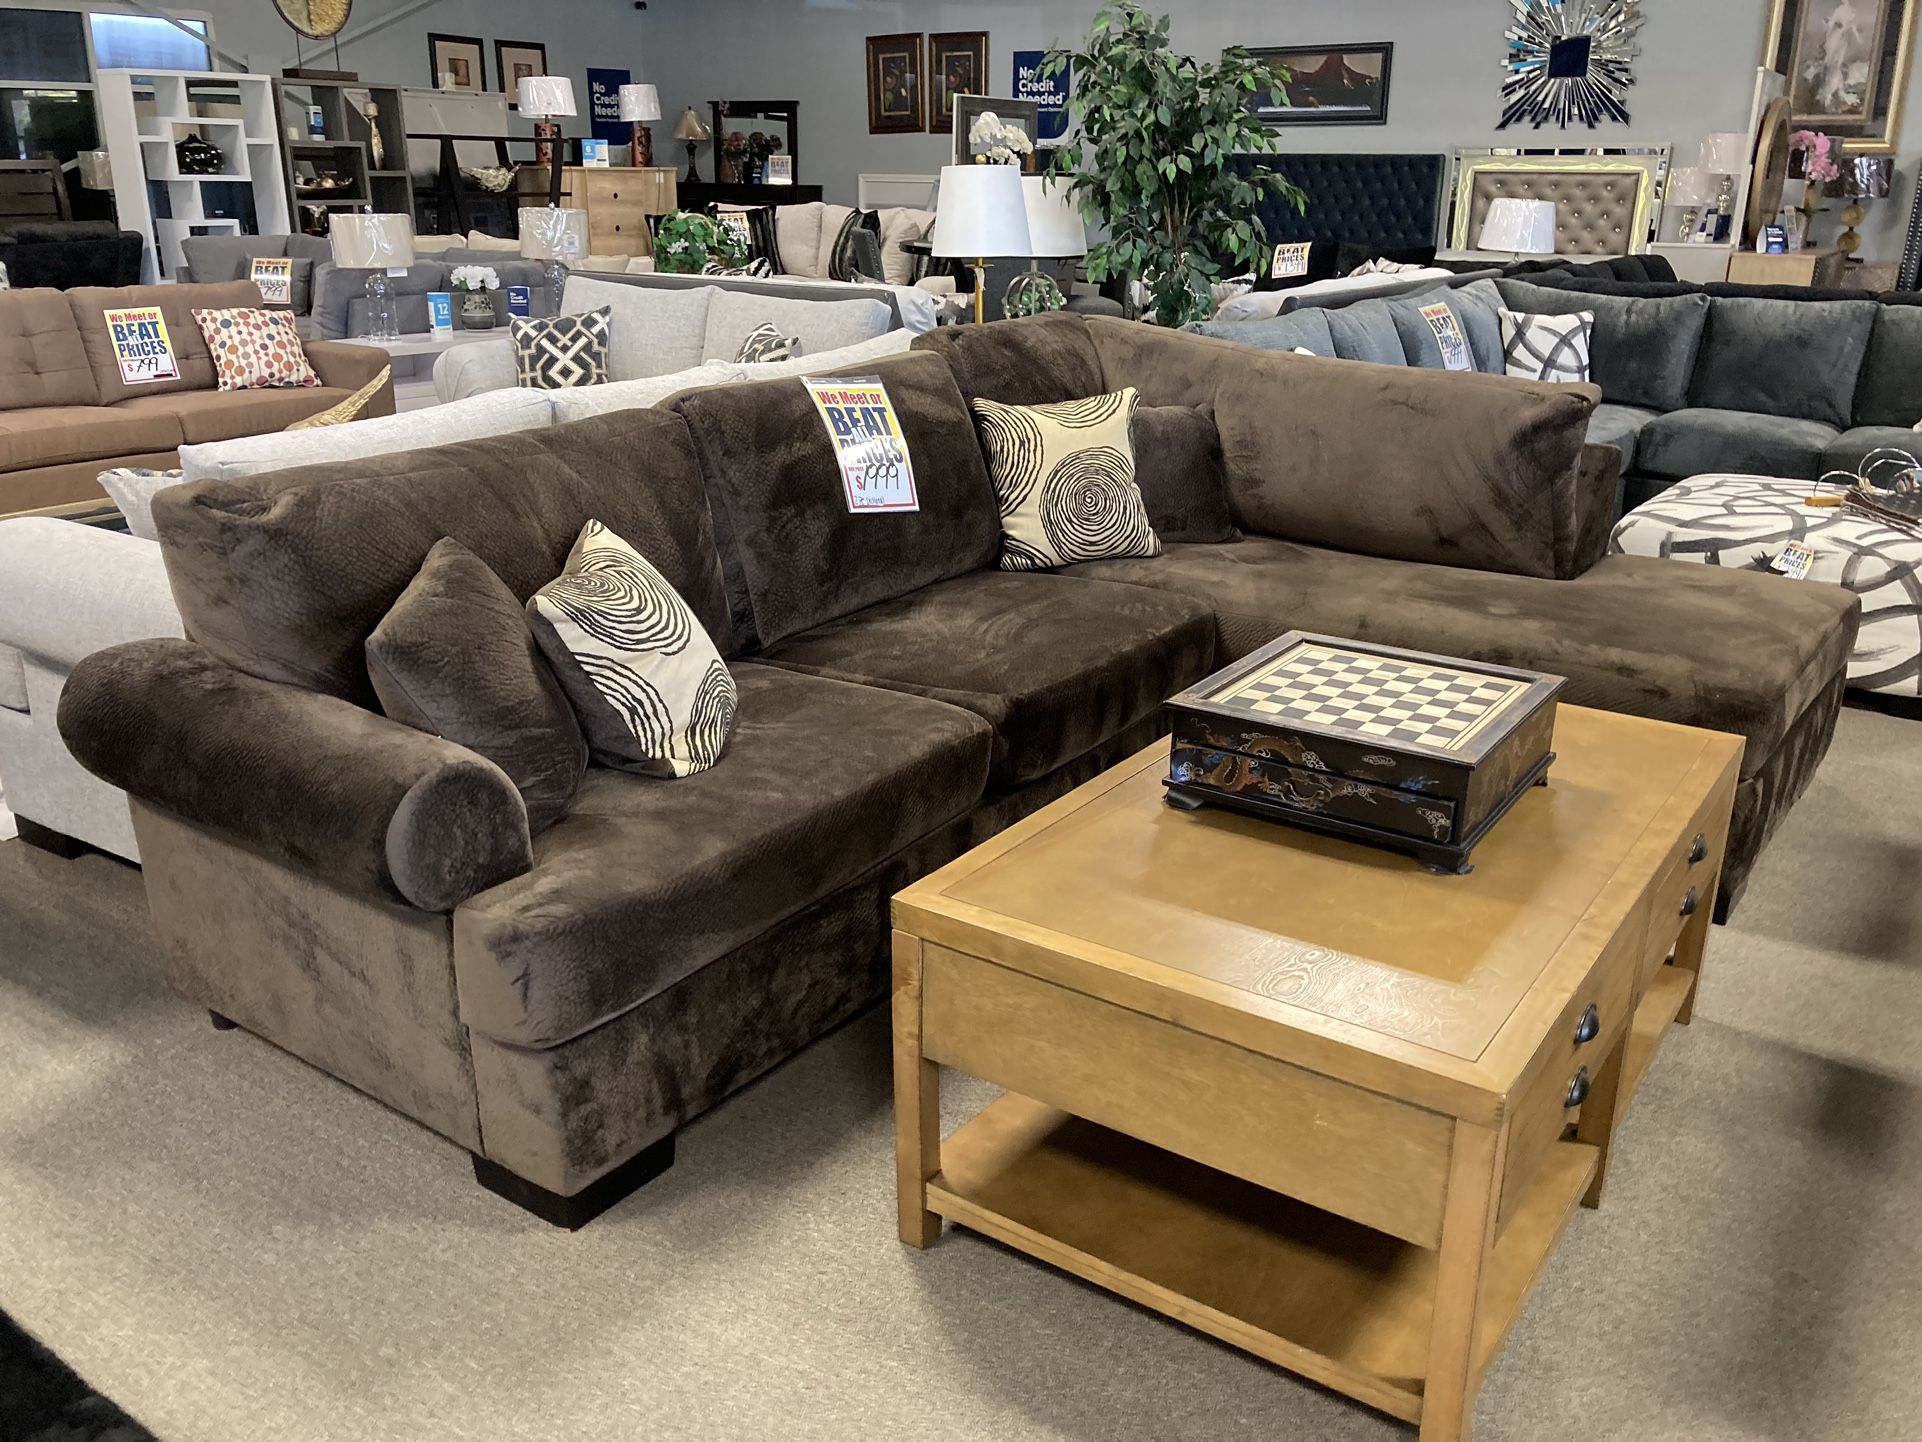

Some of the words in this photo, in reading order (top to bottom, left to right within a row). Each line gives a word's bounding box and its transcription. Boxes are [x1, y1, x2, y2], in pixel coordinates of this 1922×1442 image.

[1019, 67, 1036, 79] No
[592, 82, 606, 93] No
[1019, 80, 1055, 92] Credit
[593, 93, 620, 104] Credi
[594, 105, 620, 116] Need
[1277, 247, 1305, 256] BEAT
[1276, 254, 1305, 264] PRICES
[255, 265, 288, 276] BEAT
[438, 303, 449, 315] 12
[108, 313, 124, 323] We
[124, 312, 147, 322] Meet
[147, 312, 158, 320] or
[1428, 315, 1456, 335] BEAT
[111, 320, 161, 343] BEAT
[117, 340, 168, 358] PRICES
[816, 391, 839, 405] We
[838, 391, 871, 405] Meet
[871, 393, 883, 405] or
[825, 406, 893, 436] BEAT
[838, 437, 904, 464] PICES
[1783, 547, 1812, 562] BEAT
[1779, 556, 1807, 570] PRICES
